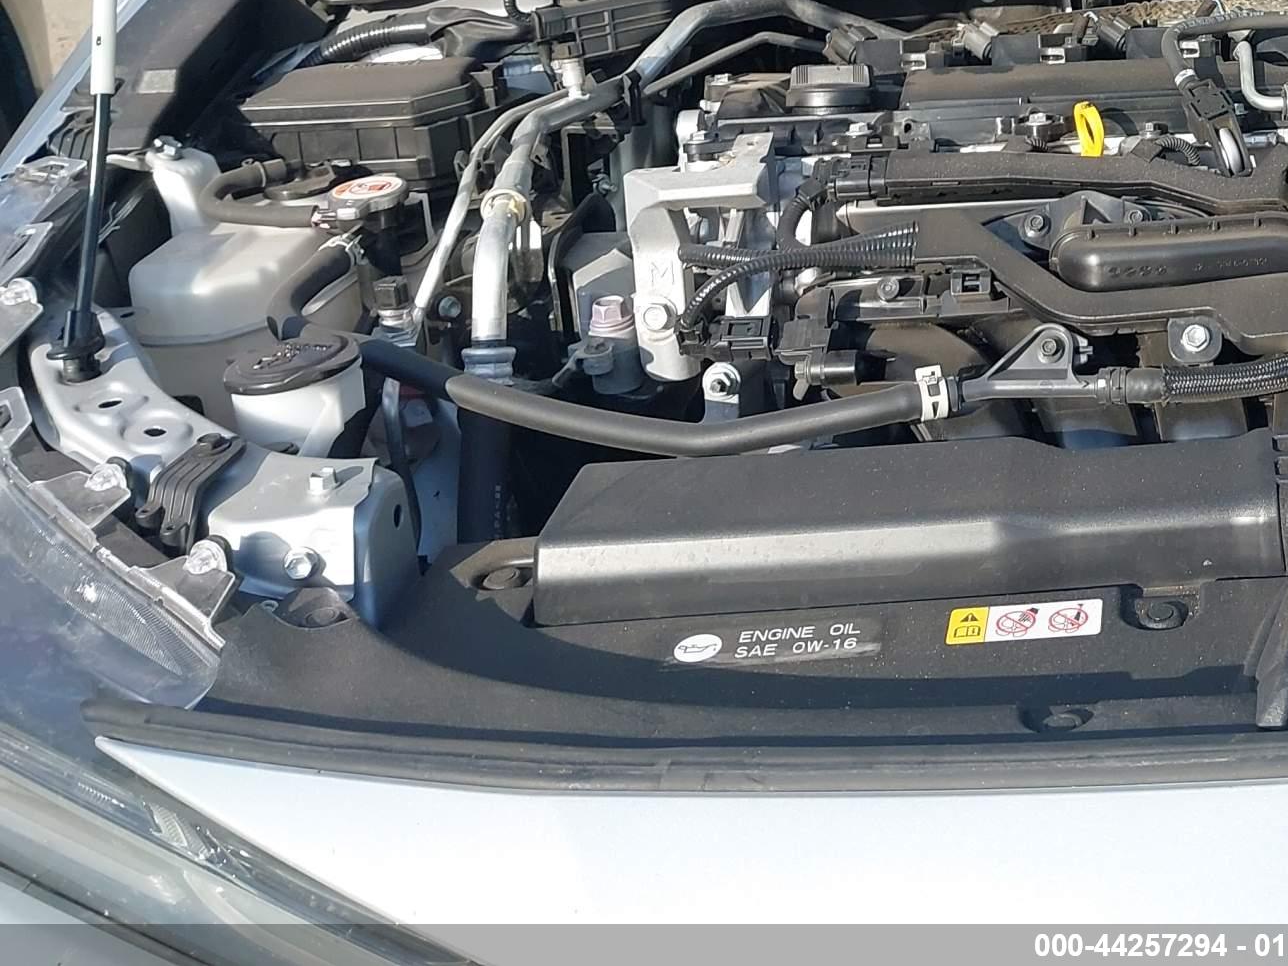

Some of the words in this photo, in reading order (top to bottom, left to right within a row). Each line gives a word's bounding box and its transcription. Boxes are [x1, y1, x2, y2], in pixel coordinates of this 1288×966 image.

[650, 261, 675, 286] M
[738, 625, 816, 644] ENGINE
[829, 622, 861, 636] OIL
[734, 643, 778, 659] SAE
[792, 637, 858, 654] 0W-16
